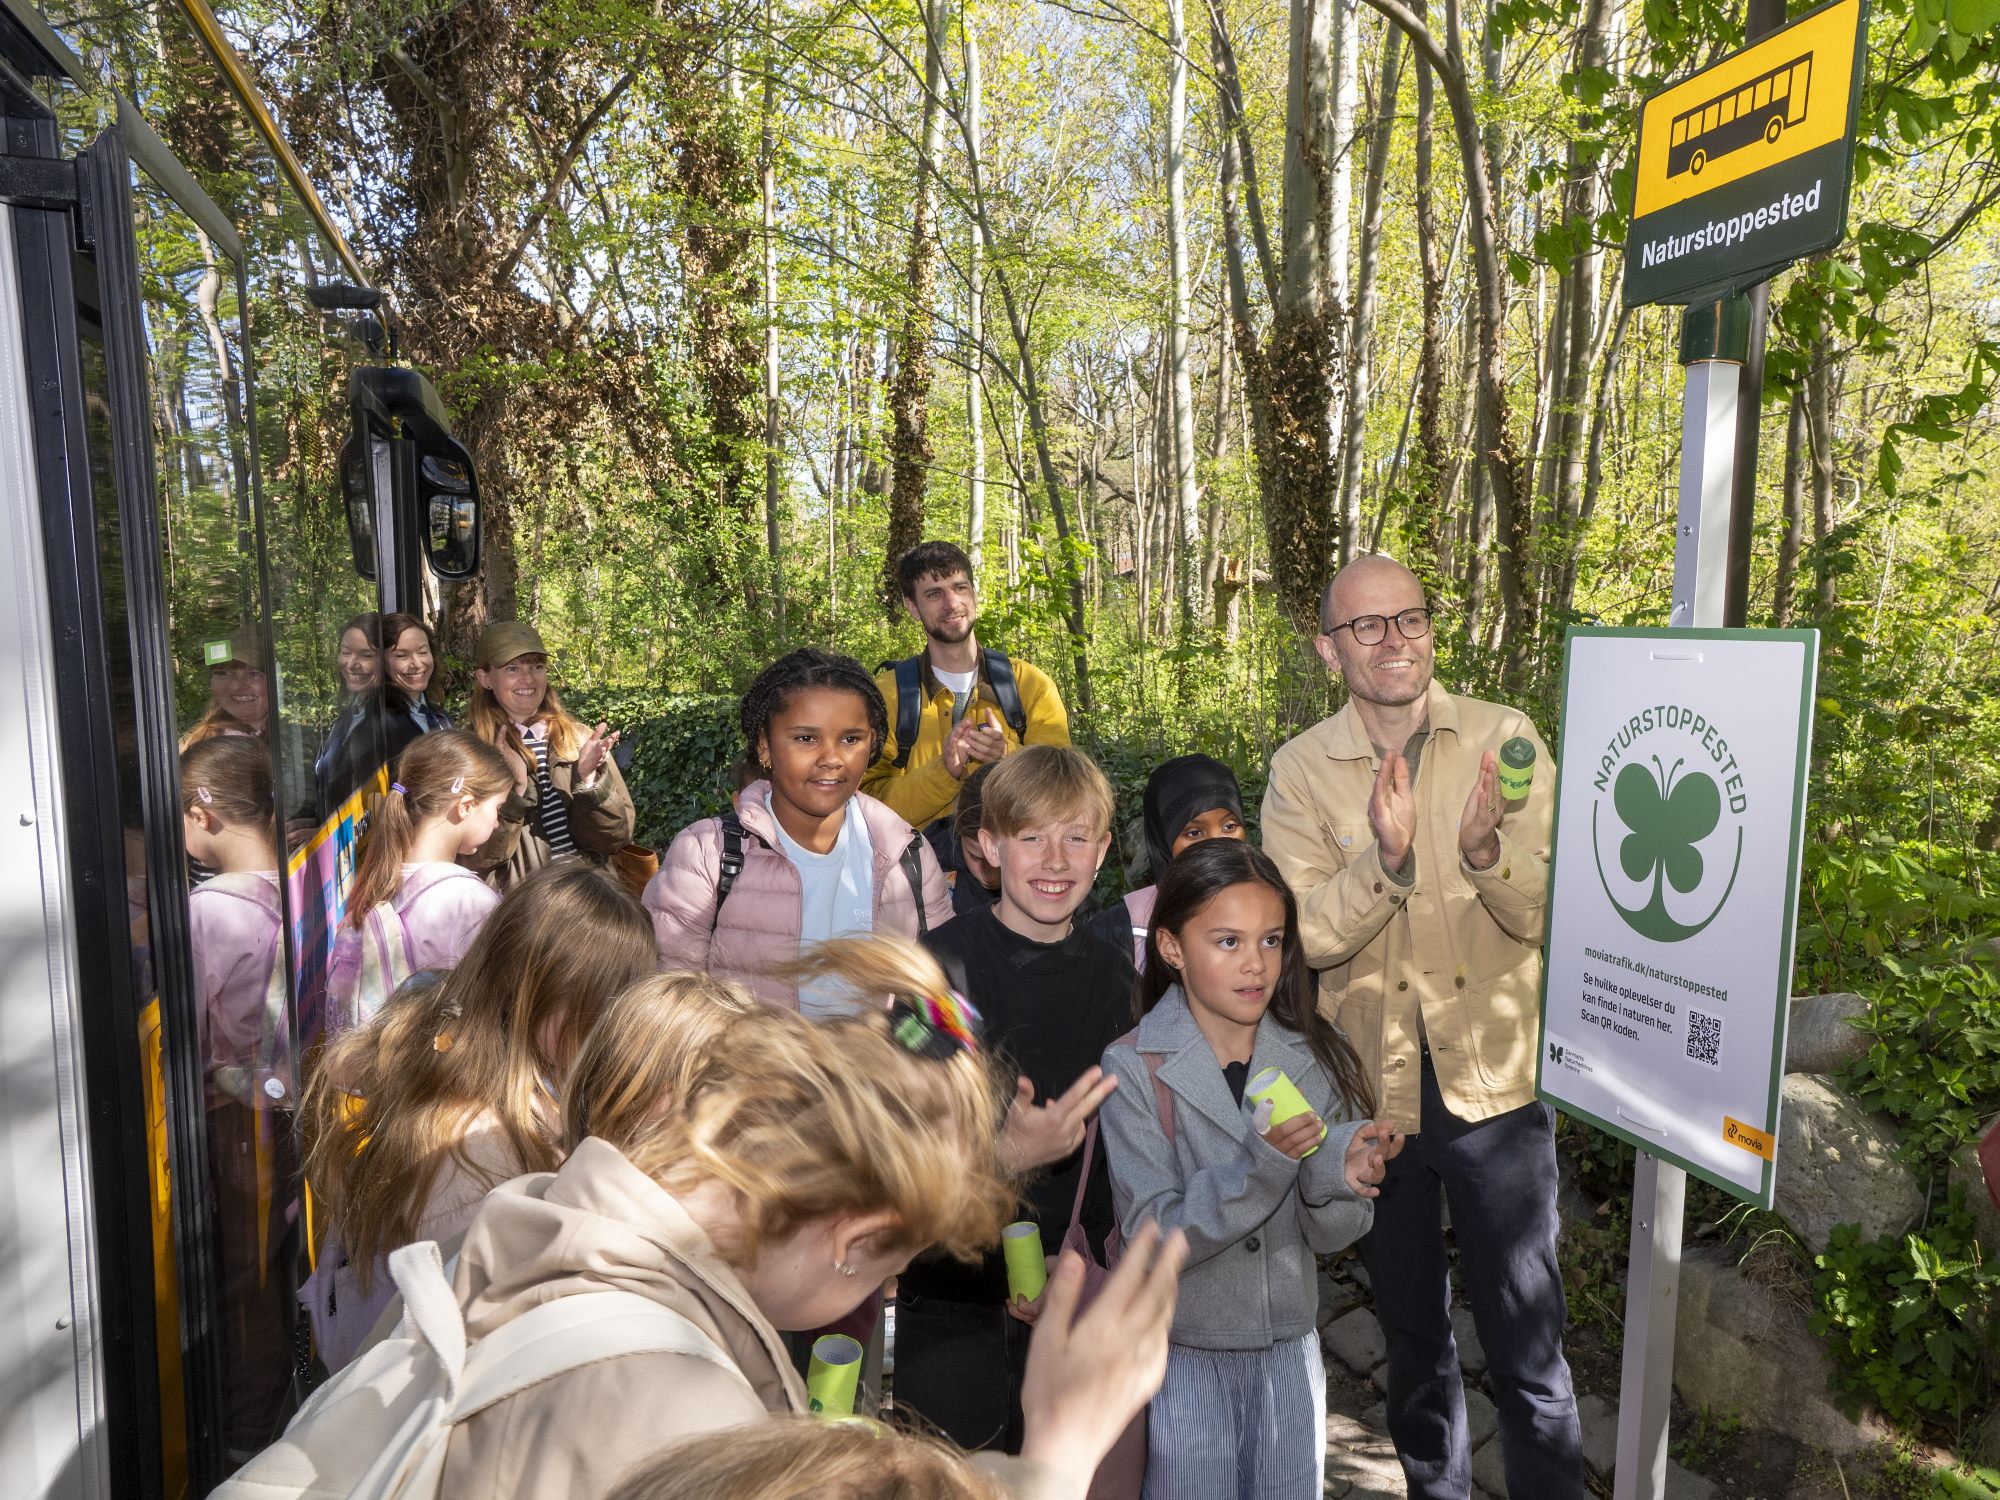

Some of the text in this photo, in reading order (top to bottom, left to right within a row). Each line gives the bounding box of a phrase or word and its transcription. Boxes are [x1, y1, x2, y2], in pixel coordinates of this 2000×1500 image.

[1641, 179, 1822, 269] Naturstoppested
[1593, 705, 1747, 814] NATURSTOPPESTED
[1583, 972, 1676, 1014] Se hvilke oplevelser du
[1584, 947, 1728, 1001] moviatrafik.dk/naturstoppested
[1581, 1008, 1640, 1041] Scan QR koden.
[1582, 990, 1596, 1004] kan
[1597, 996, 1618, 1013] finde
[1622, 1007, 1655, 1028] naturen
[1656, 1018, 1673, 1034] her.
[1737, 1134, 1763, 1151] movia
